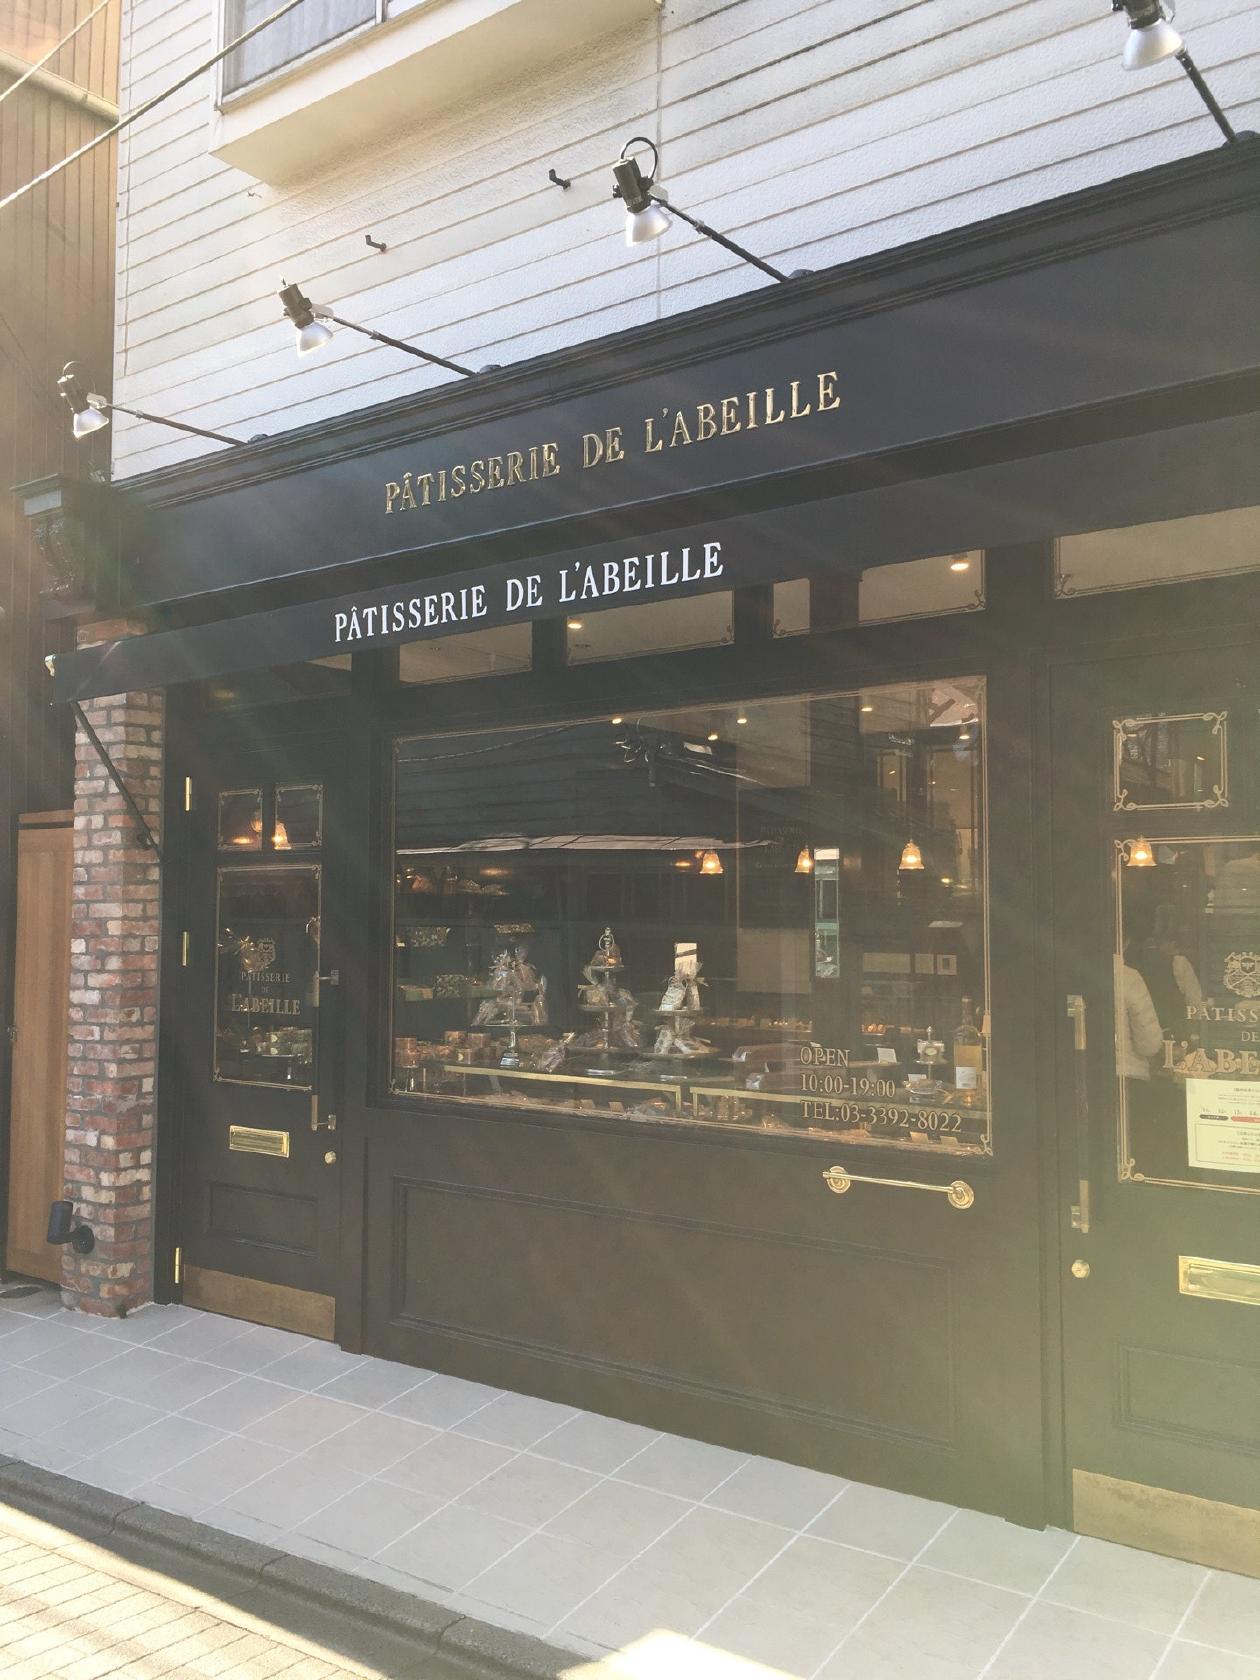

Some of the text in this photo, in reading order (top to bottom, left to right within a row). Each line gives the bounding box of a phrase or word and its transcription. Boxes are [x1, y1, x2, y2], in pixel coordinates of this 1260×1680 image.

[385, 371, 842, 514] PÂTISSERIE DE L'ABEILLE
[334, 541, 725, 642] PÂTISSERIE DE L'ABEILLE
[800, 1046, 850, 1067] OPEN
[800, 1073, 896, 1098] 10:00-19:00
[800, 1101, 963, 1133] TEL:03-3392-8022
